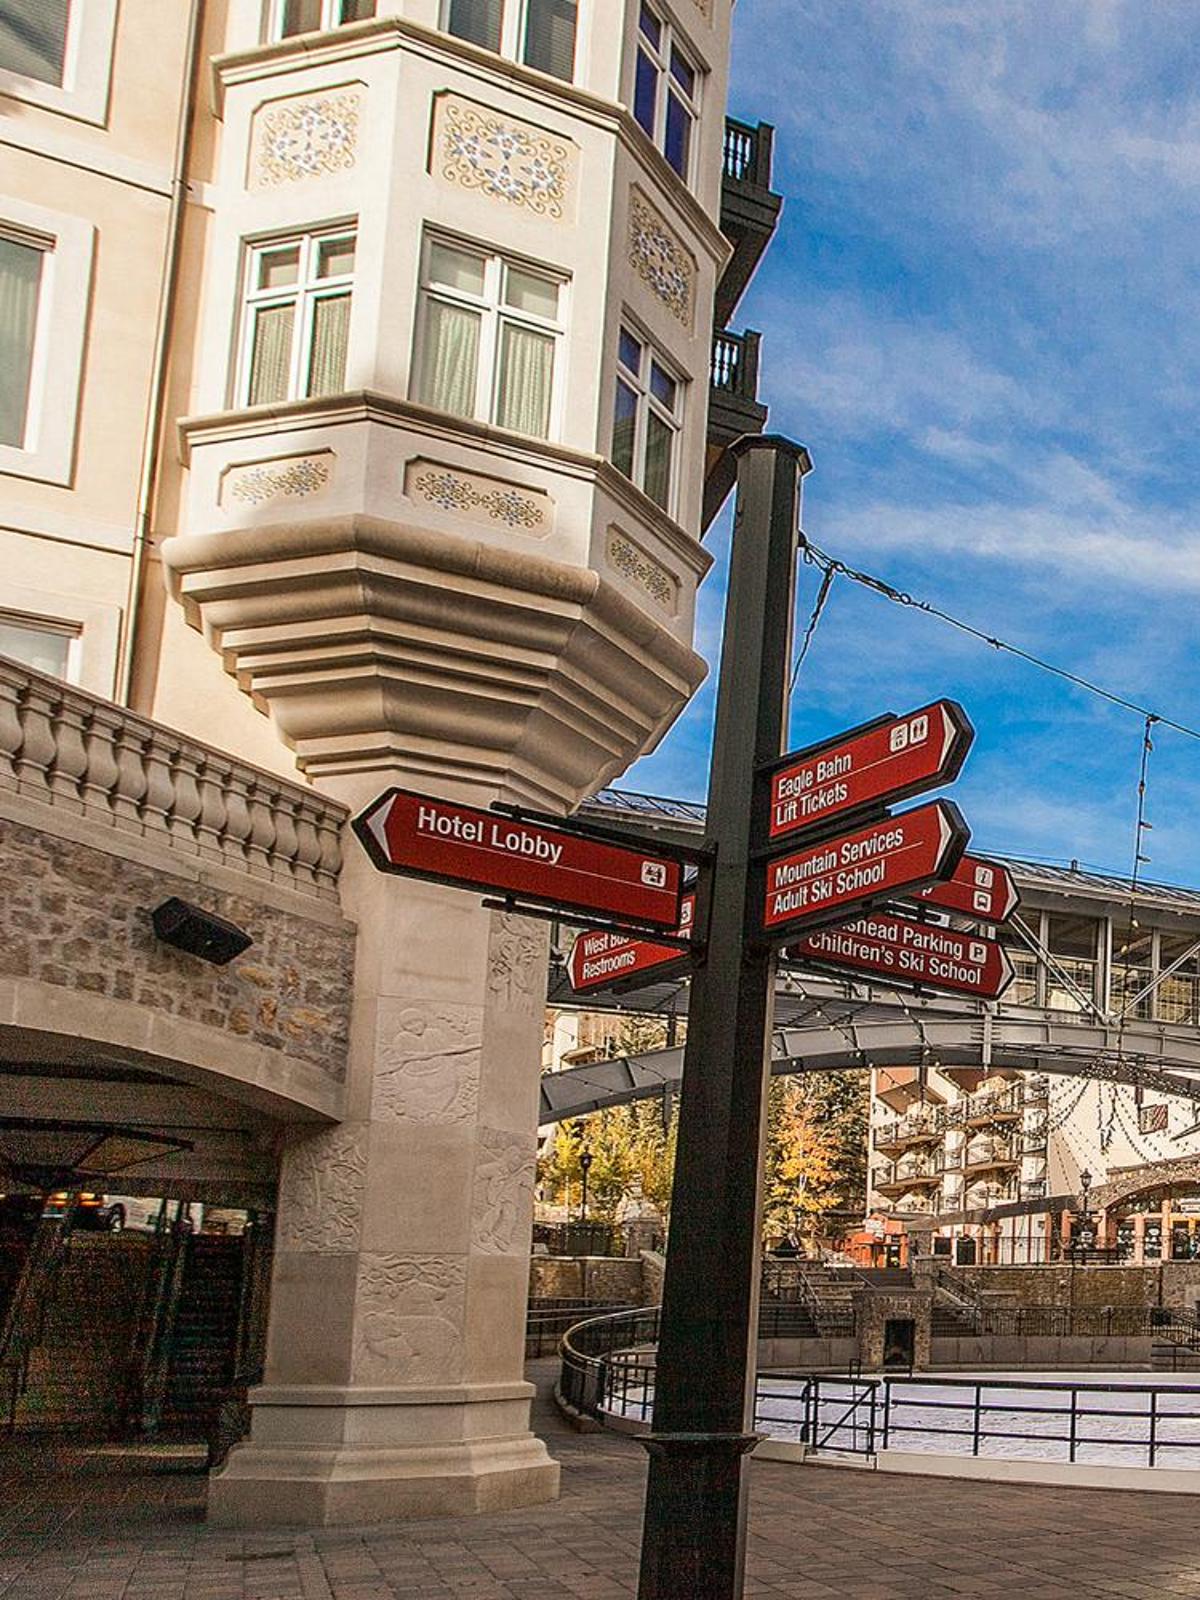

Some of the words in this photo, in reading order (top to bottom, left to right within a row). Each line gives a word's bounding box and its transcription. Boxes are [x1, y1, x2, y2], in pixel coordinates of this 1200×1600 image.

[777, 768, 813, 799] Eagle
[816, 754, 852, 782] Bahn
[776, 800, 798, 826] Lift
[800, 784, 848, 817] Tickets
[417, 806, 483, 842] Hotel
[491, 825, 563, 866] Lobby
[775, 850, 837, 888] Mountain
[841, 828, 904, 864] Services
[773, 887, 808, 915] Adult
[811, 876, 833, 903] Ski
[836, 862, 885, 895] School
[582, 950, 636, 980] Restrooms
[584, 933, 609, 956] West
[903, 930, 964, 961] Parking
[899, 950, 924, 972] Ski
[929, 957, 981, 985] School
